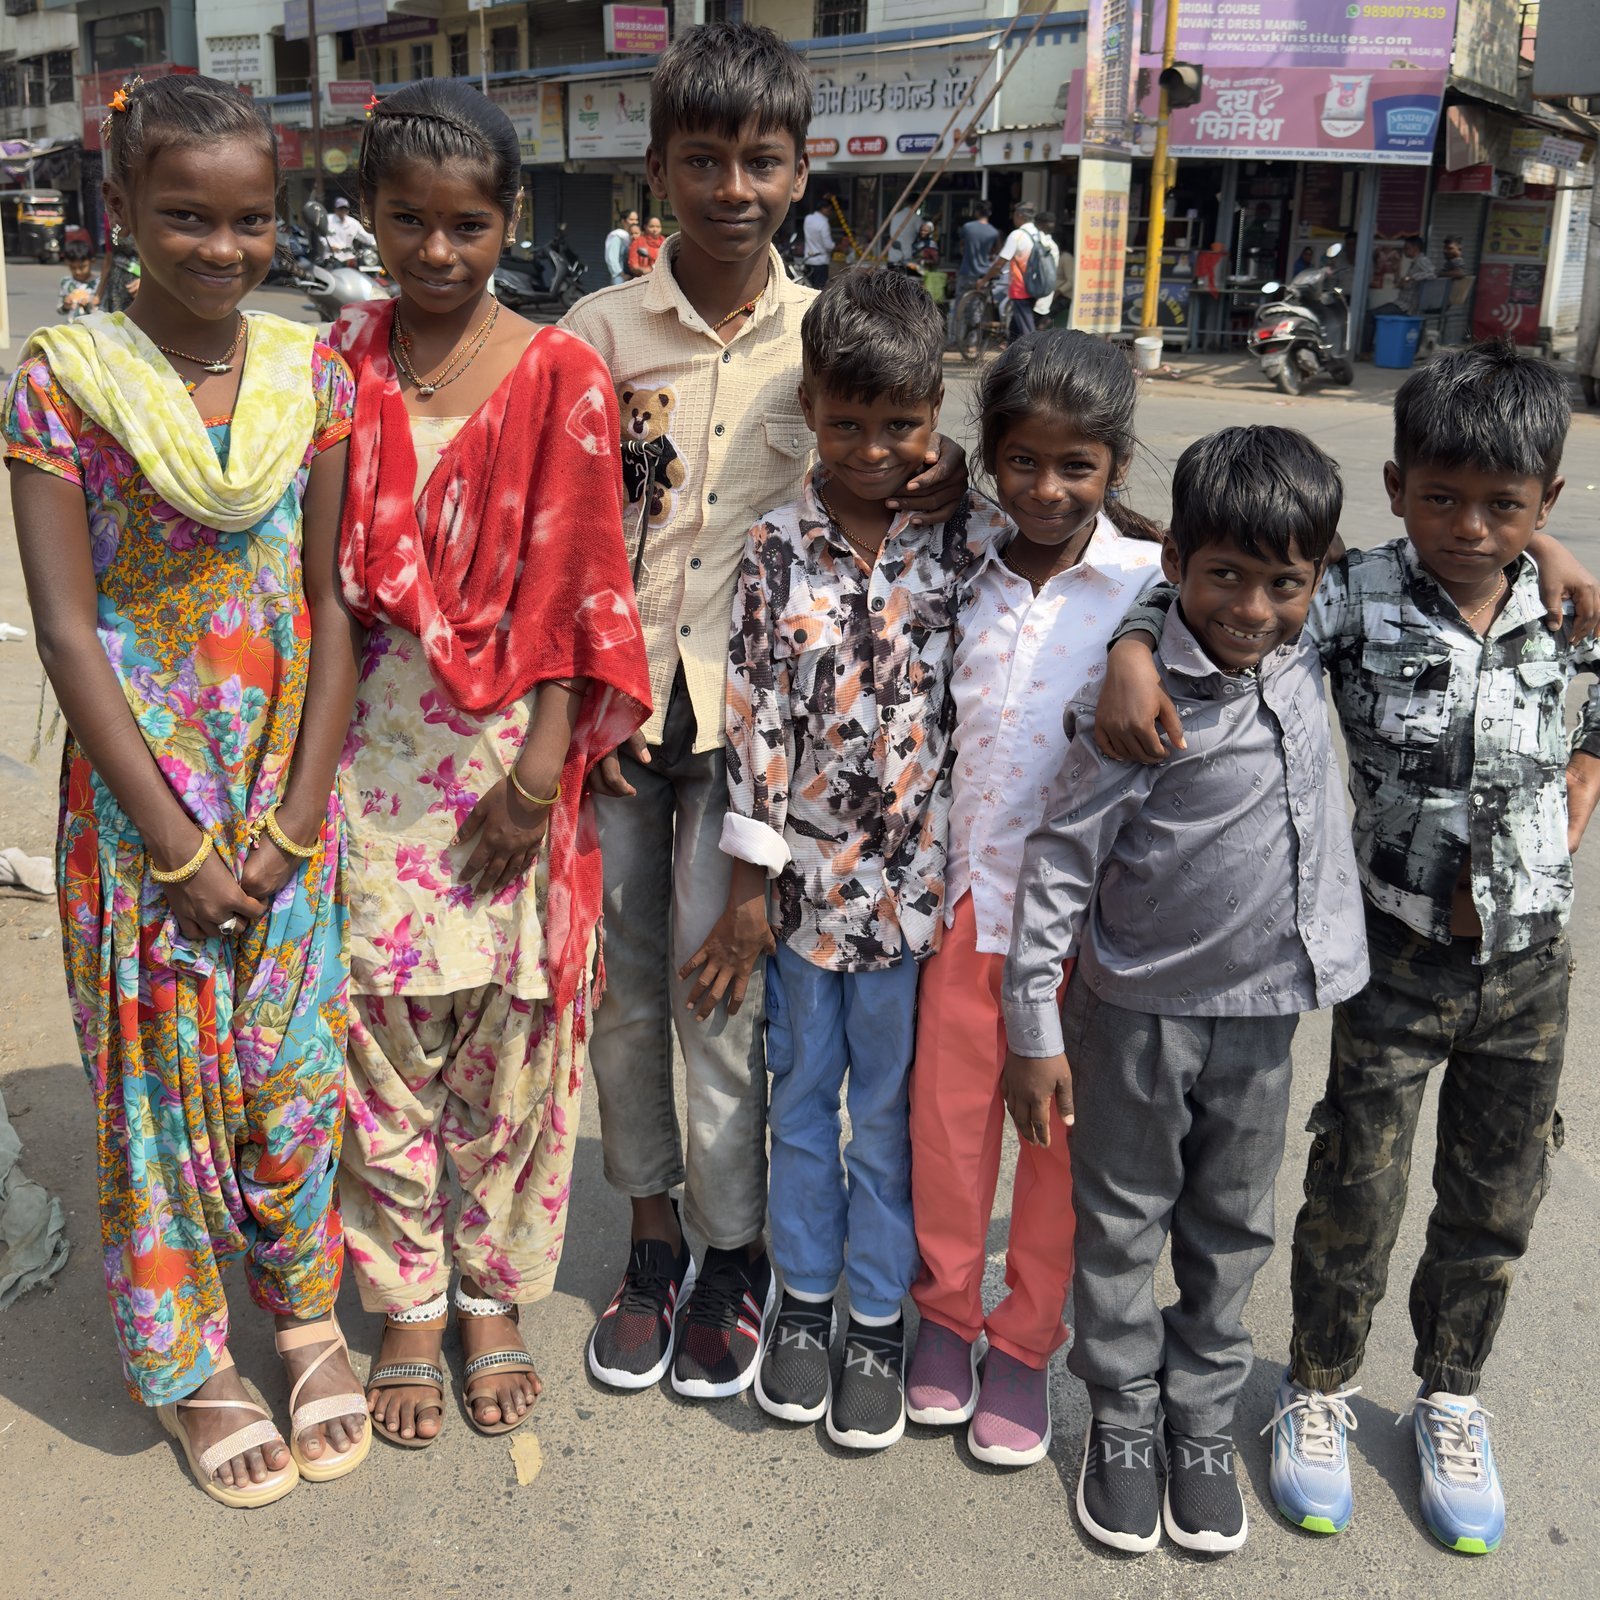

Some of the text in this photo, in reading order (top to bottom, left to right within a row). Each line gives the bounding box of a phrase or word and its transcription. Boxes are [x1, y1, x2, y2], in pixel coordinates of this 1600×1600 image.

[1177, 3, 1261, 15] BRIDAL COURSE
[1362, 4, 1447, 19] 9890079439
[1177, 17, 1308, 31] ADVANCE DRESS MAKING
[1210, 31, 1412, 45] www.vkinstitutes.com
[626, 41, 656, 49] CLASSES
[1207, 42, 1245, 52] SHOPPING
[1359, 46, 1383, 55] UNION
[1216, 89, 1258, 115] दूध
[1390, 112, 1432, 125] MOTHER
[1195, 110, 1285, 141] फिनिश
[1396, 122, 1423, 132] DAIRY
[1255, 149, 1372, 160] NIRANKARI RAJMATA TEA HOUSE
